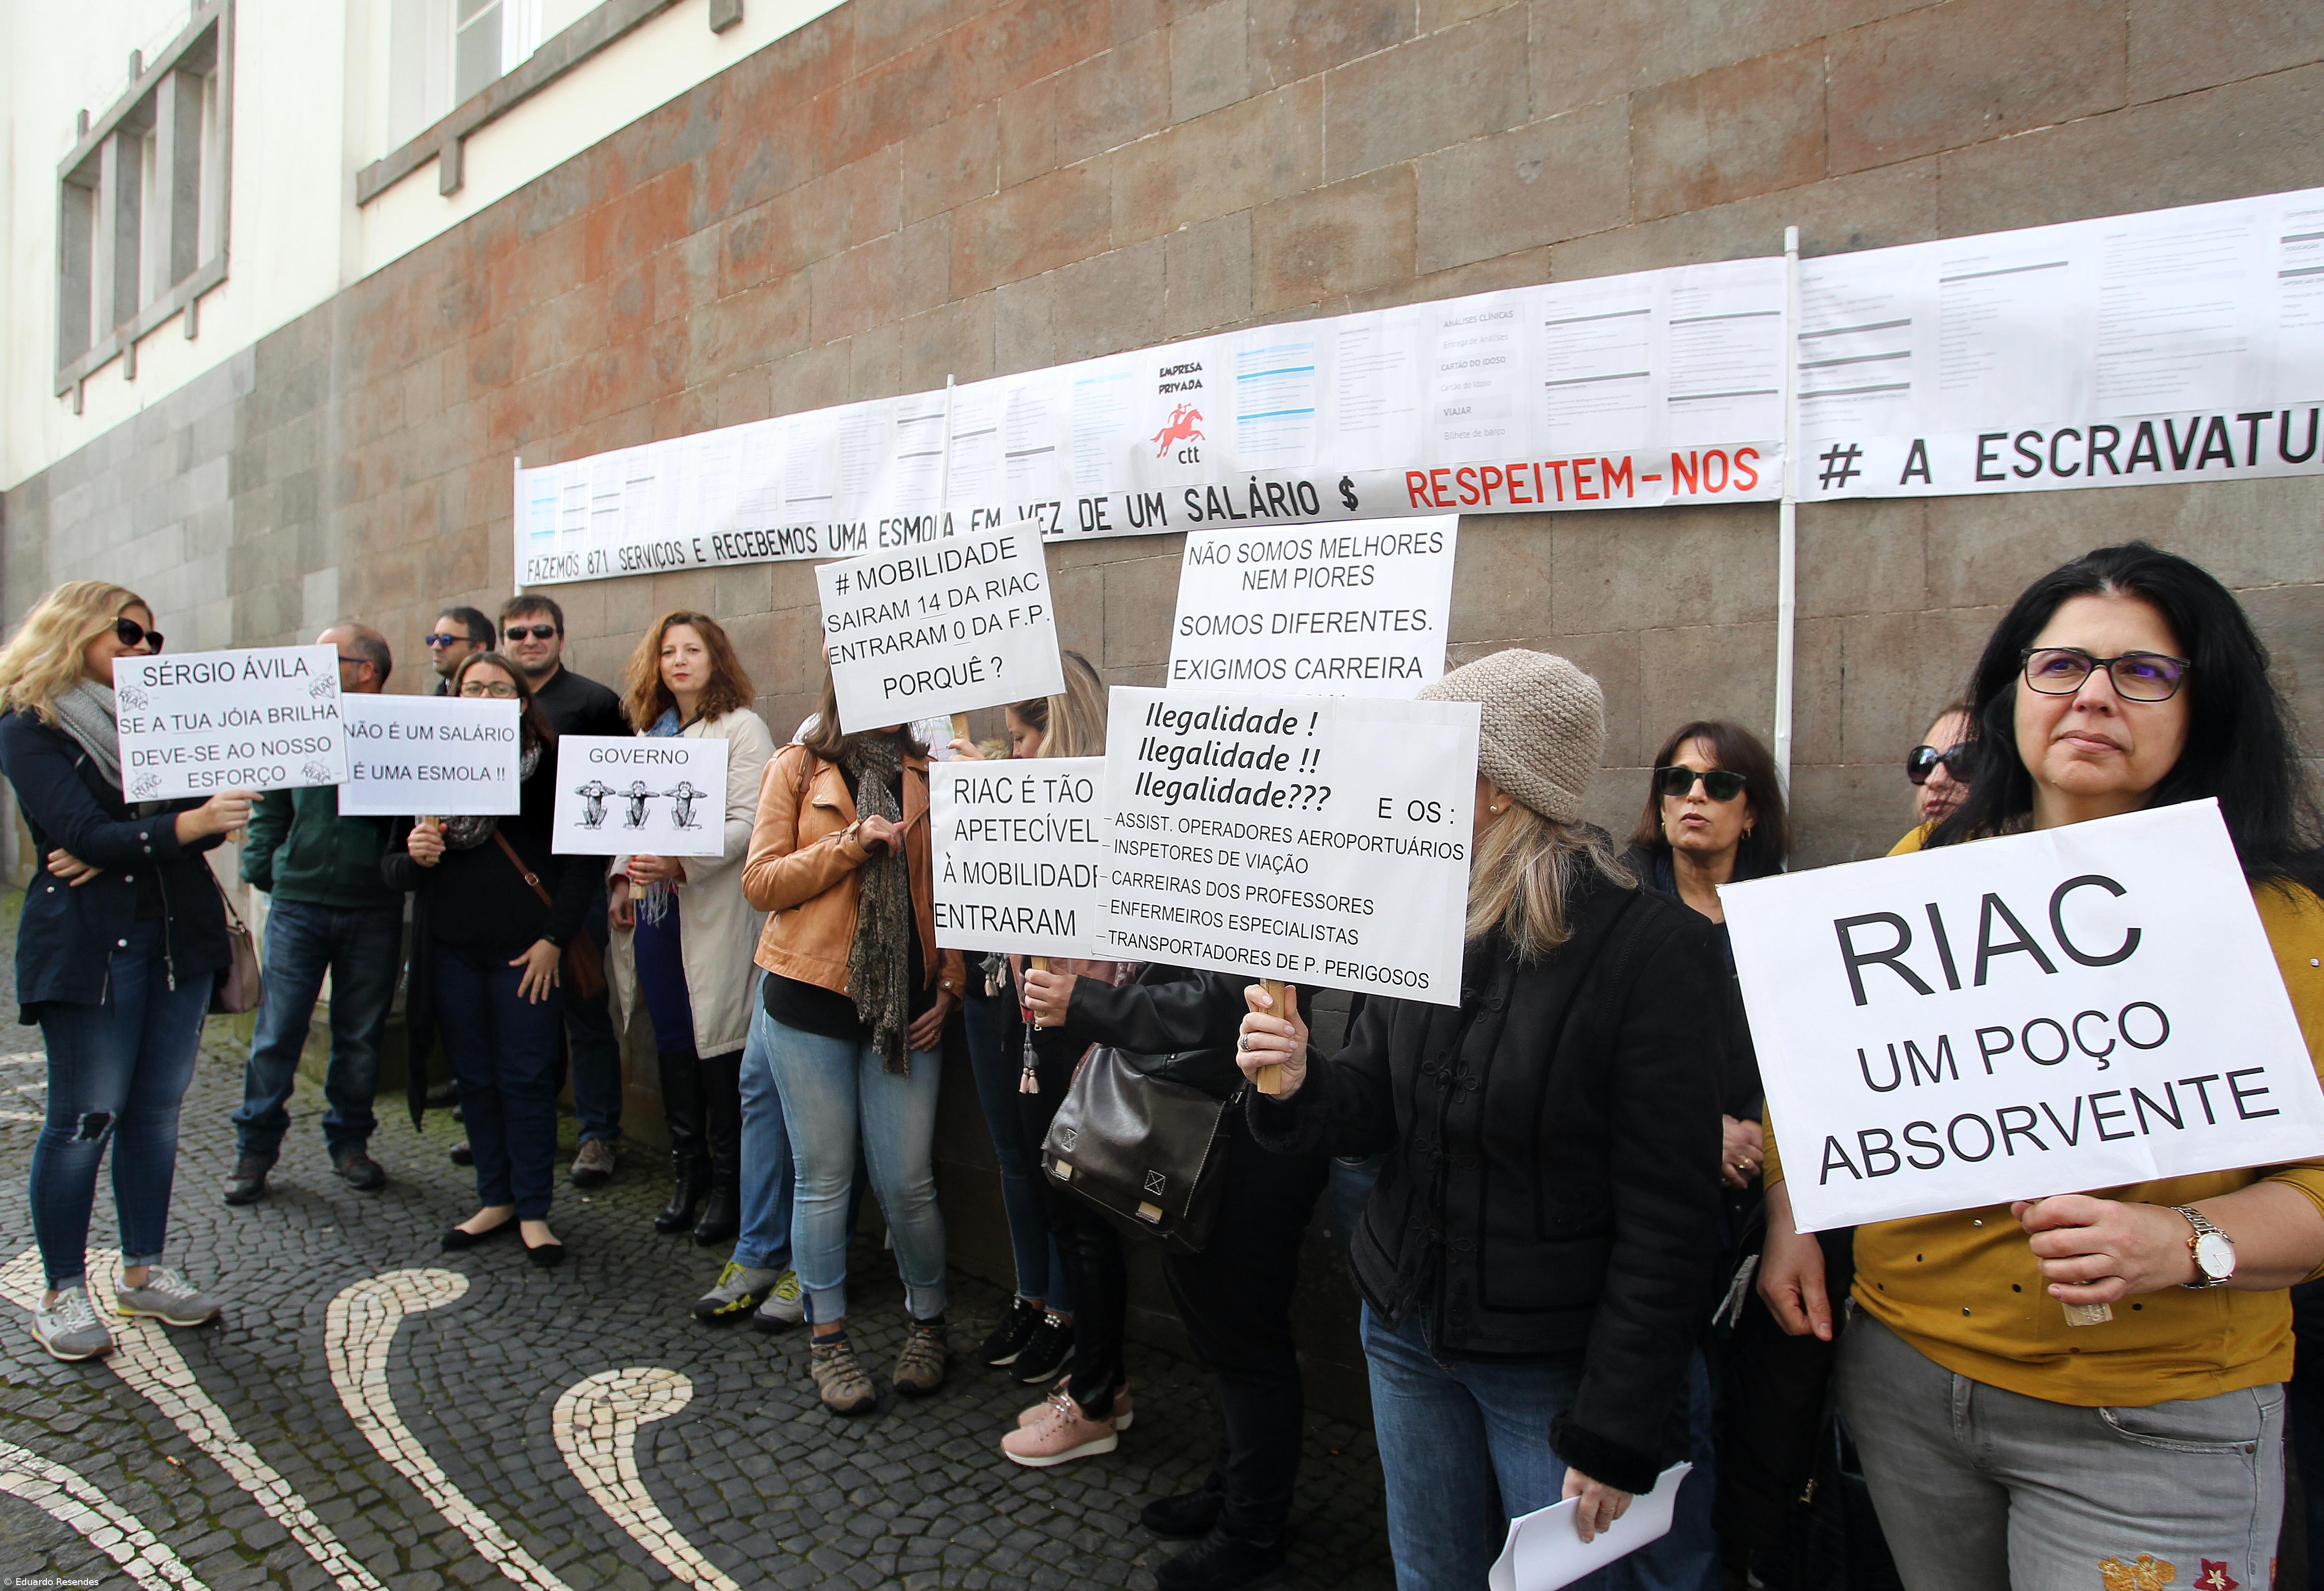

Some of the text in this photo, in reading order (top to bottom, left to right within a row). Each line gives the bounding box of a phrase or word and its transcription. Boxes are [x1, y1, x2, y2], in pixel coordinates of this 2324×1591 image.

[1160, 362, 1202, 377] EMPRESA
[1442, 361, 1468, 371] CARTÃO
[1483, 356, 1506, 365] IDOSO
[1159, 379, 1203, 394] PRIVADA
[1444, 407, 1471, 416] VIAJAR
[1179, 447, 1200, 464] ctt
[1900, 439, 1931, 485] A
[1976, 408, 2324, 481] ESCRAVATU
[528, 554, 579, 581] FAZEMOS
[588, 550, 608, 574] 871
[619, 541, 685, 570] SERVIÇOS
[693, 539, 706, 562] E
[712, 527, 817, 560] RECEBEMOS
[829, 523, 867, 551] UMA
[1079, 497, 1112, 531] DE
[1126, 493, 1167, 528] UM
[1185, 475, 1320, 522] SALÁRIO
[1406, 448, 1759, 508] RESPEITEM-NOS
[856, 537, 1017, 591] MOBILIDADE
[1189, 532, 1443, 565] NÃO SOMOS MELHORES
[1243, 565, 1374, 590] NEM PIORES
[828, 573, 1039, 632] SAIRAM 14 DA RIAC
[1180, 609, 1432, 636] SOMOS DIFERENTES.
[830, 625, 947, 665] ENTRARAM
[954, 621, 965, 639] 0
[972, 614, 1002, 635] DA
[144, 656, 308, 686] SÉRGIO ÁVILA
[884, 656, 984, 699] PORQUÊ
[1174, 657, 1422, 679] EXIGIMOS CARREIRA
[121, 704, 338, 733] SE A TUA JÓIA BRILHA
[343, 721, 514, 741] NÃO É UM SALÁRIO
[1146, 702, 1297, 735] Ilegalidade
[132, 737, 331, 766] DEVE-SE AO NOSSO
[589, 749, 688, 764] GOVERNO
[1139, 737, 1289, 771] Ilegalidade
[188, 766, 285, 788] ESFORÇO
[354, 762, 364, 779] É
[372, 766, 411, 779] UMA
[418, 766, 491, 780] ESMOLA
[955, 774, 1092, 803] RIAC É TÃO
[1135, 772, 1330, 811] Ilegalidade???
[1379, 798, 1392, 818] E
[1408, 800, 1441, 823] OS
[955, 813, 1098, 842] APETECÍVEL
[1116, 812, 1172, 831] ASSIST.
[1179, 818, 1292, 843] OPERADORES
[1297, 830, 1463, 860] AEROPORTUÁRIOS
[944, 852, 956, 883] À
[1115, 839, 1212, 863] INSPETORES
[1219, 850, 1240, 866] DE
[1246, 853, 1308, 875] VIAÇÃO
[1112, 871, 1200, 894] CARREIRAS
[1206, 881, 1240, 899] DOS
[1246, 886, 1373, 915] PROFESSORES
[935, 903, 1075, 936] ENTRARAM
[1111, 900, 1222, 927] ENFERMEIROS
[1229, 915, 1358, 945] ESPECIALISTAS
[1834, 875, 2141, 1006] RIAC
[1109, 930, 1270, 966] TRANSPORTADORES
[1277, 953, 1298, 970] DE
[1305, 957, 1318, 973] P.
[1326, 960, 1428, 988] PERIGOSOS
[1857, 1002, 2170, 1092] UM POÇO
[1819, 1066, 2281, 1186] ABSORVENTE
